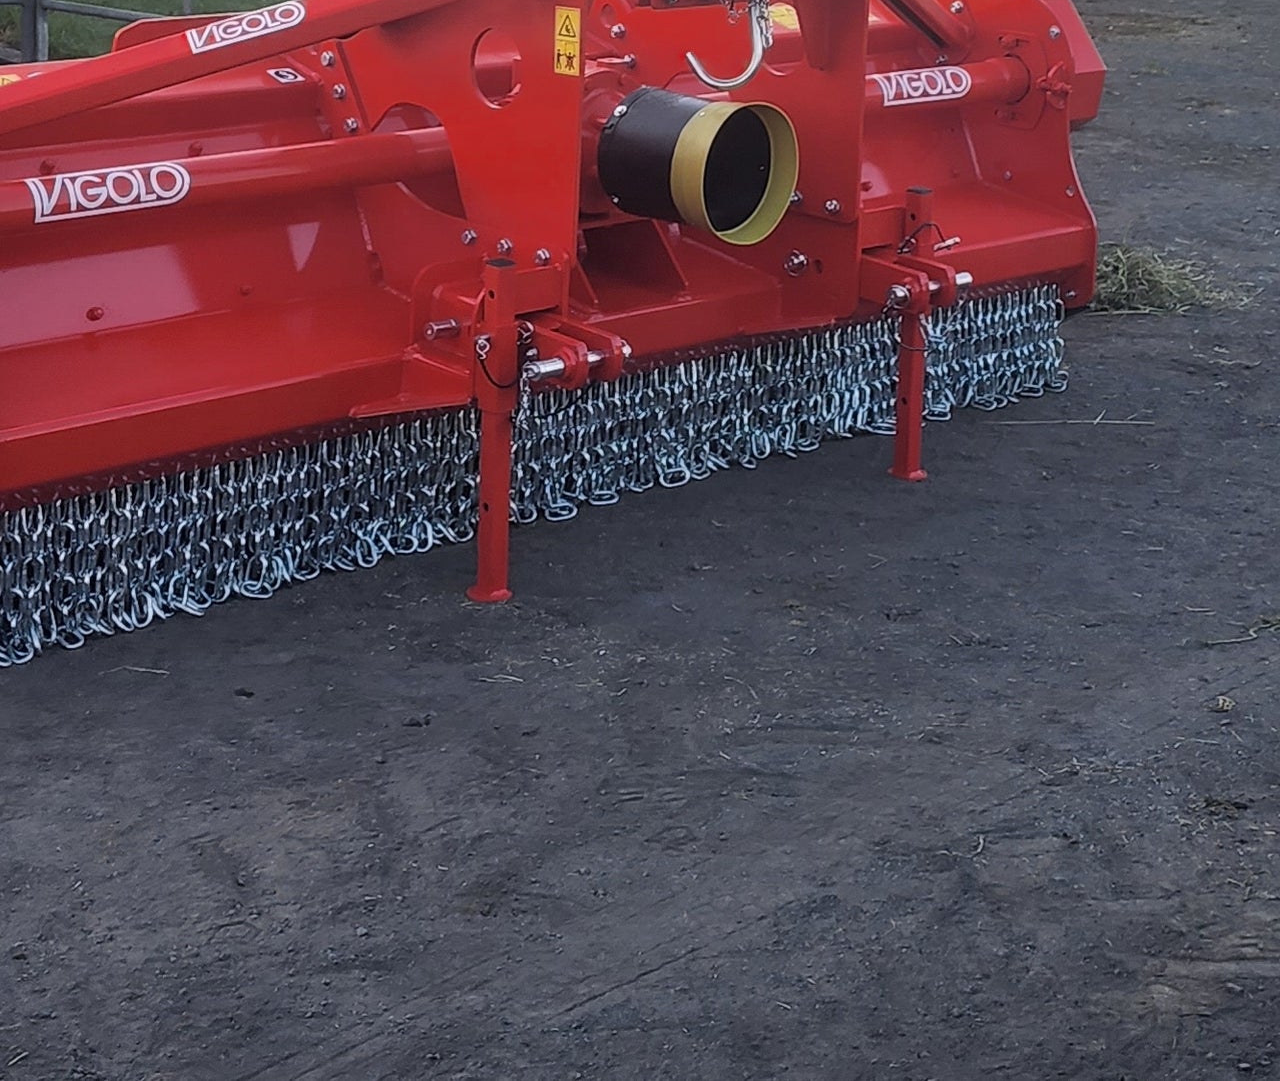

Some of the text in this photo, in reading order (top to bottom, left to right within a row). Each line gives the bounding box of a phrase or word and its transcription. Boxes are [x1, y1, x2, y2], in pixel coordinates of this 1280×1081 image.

[187, 2, 303, 51] VIGOLO
[875, 68, 969, 103] VIGOLO
[27, 164, 187, 219] VIGOLO
